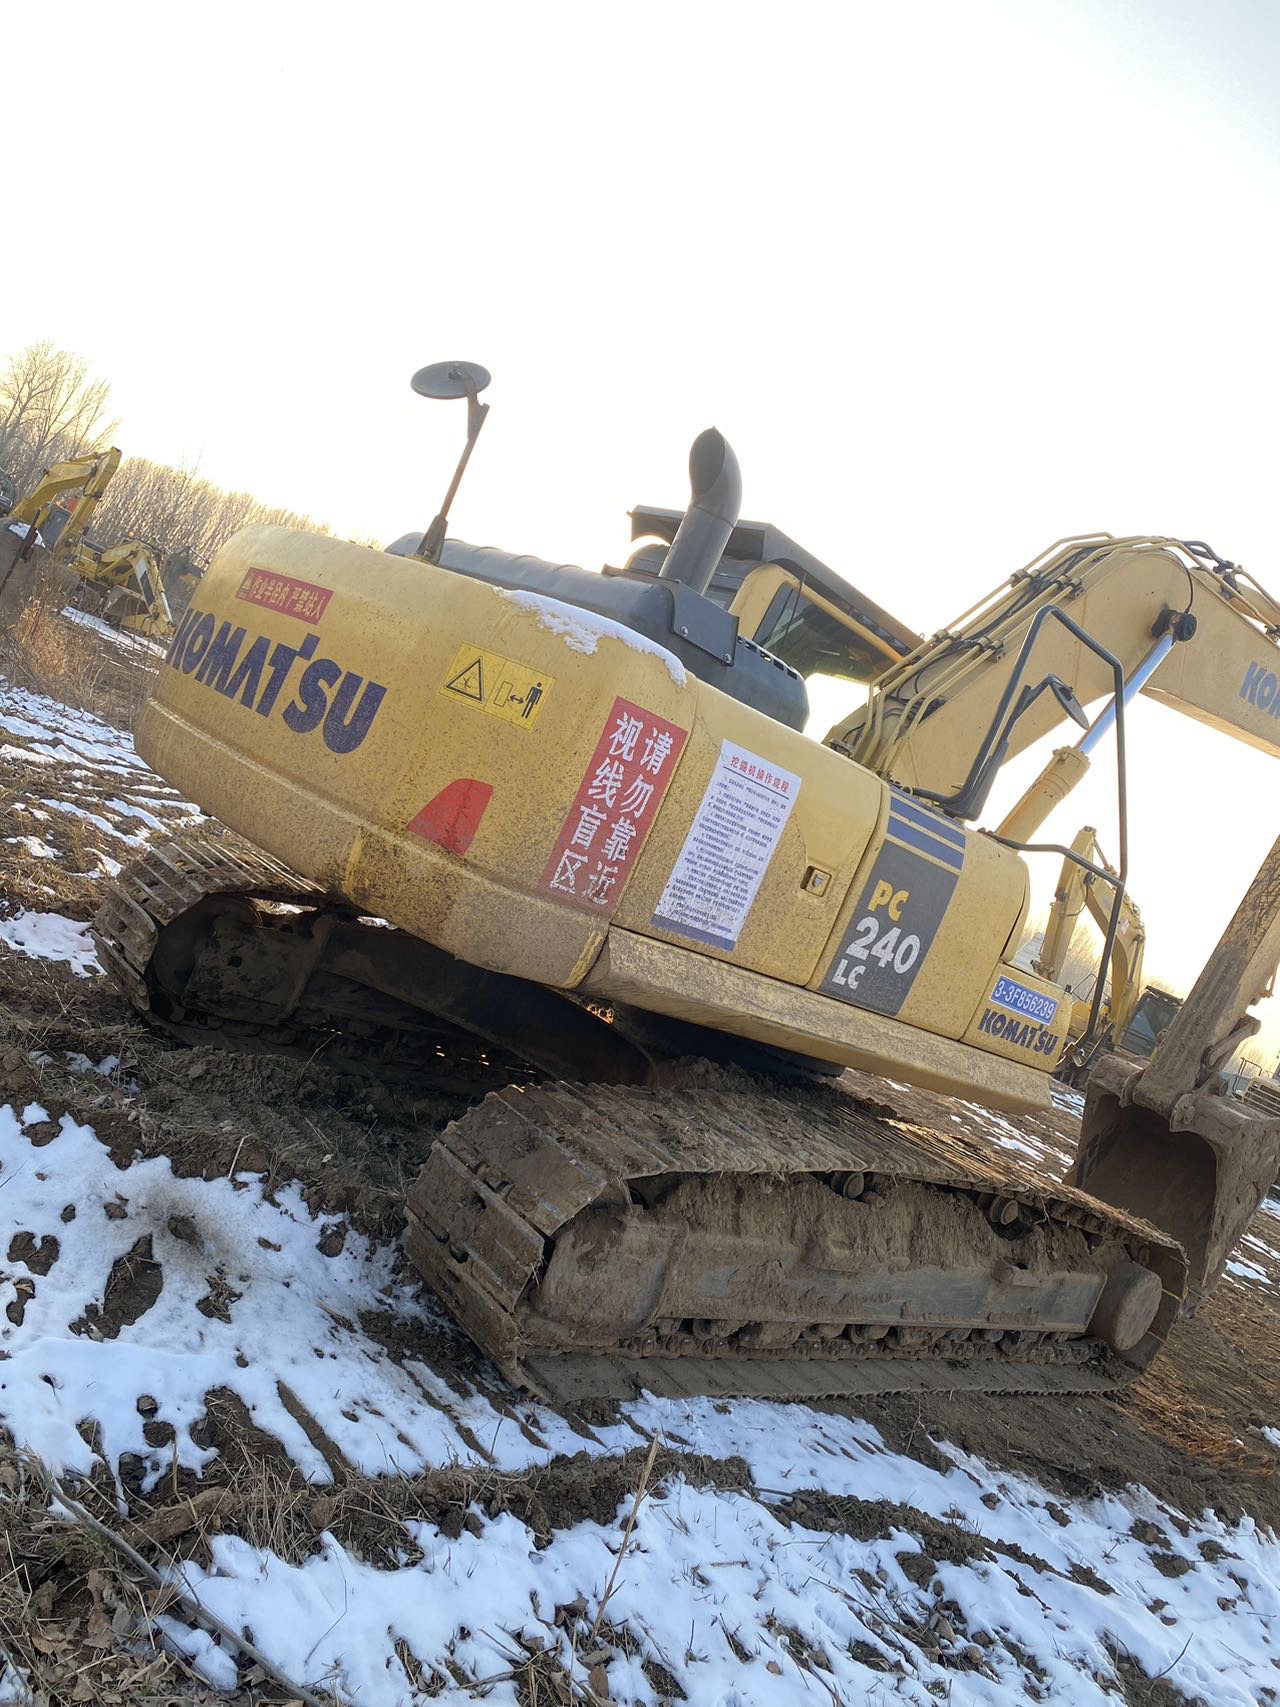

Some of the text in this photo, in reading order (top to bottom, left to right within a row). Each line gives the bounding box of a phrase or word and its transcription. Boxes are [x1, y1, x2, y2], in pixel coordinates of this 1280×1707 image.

[284, 586, 326, 620] 严禁站人
[166, 608, 387, 754] KOMATSU
[550, 712, 643, 894] 视线盲区
[583, 727, 673, 905] 请勿靠近
[867, 879, 910, 922] PC
[845, 916, 921, 974] 240
[831, 958, 866, 990] LC
[994, 980, 1055, 1020] 3-3F856239
[978, 1008, 1059, 1056] KOMATSU
